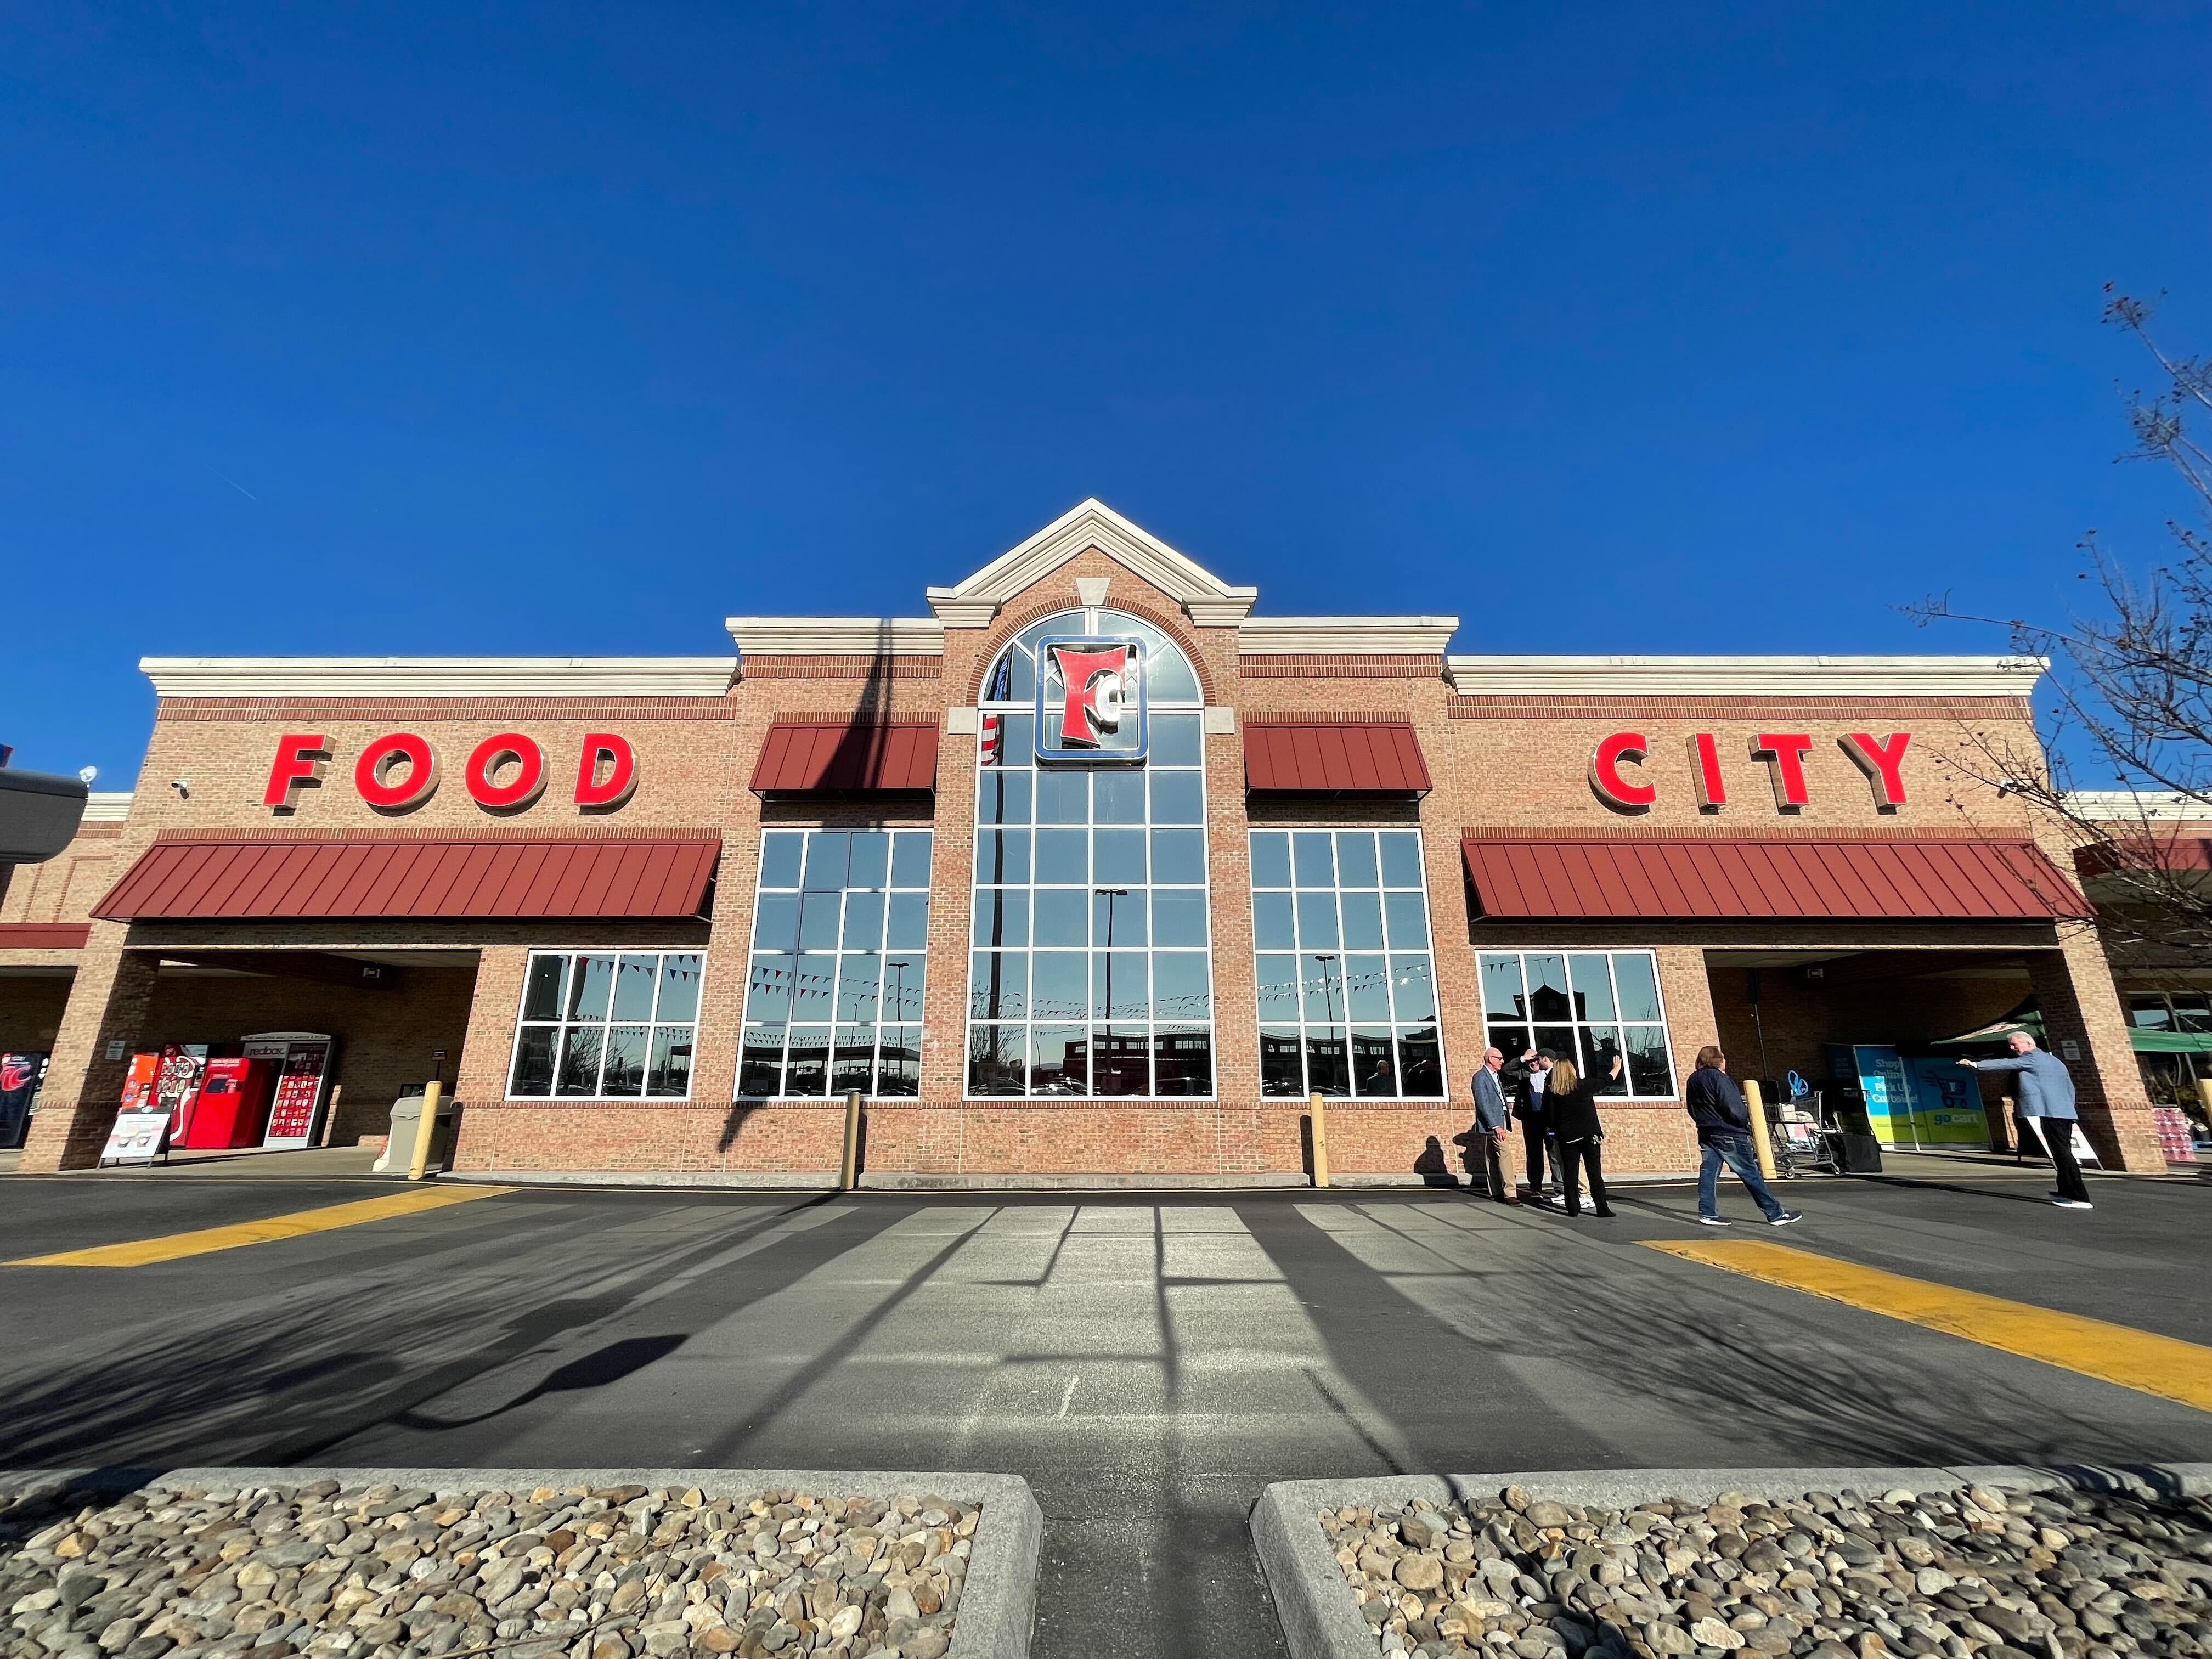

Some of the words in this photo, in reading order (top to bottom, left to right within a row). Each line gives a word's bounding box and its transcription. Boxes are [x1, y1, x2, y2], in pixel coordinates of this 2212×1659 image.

[263, 732, 637, 811] FOOD
[1589, 732, 1912, 809] CITY
[249, 1046, 285, 1056] redbox
[1876, 1059, 1900, 1070] Shop
[1874, 1070, 1906, 1079] Onlin
[1874, 1082, 1897, 1092] Pick
[1872, 1093, 1918, 1103] Curbsie!
[1934, 1114, 1979, 1125] gocart
